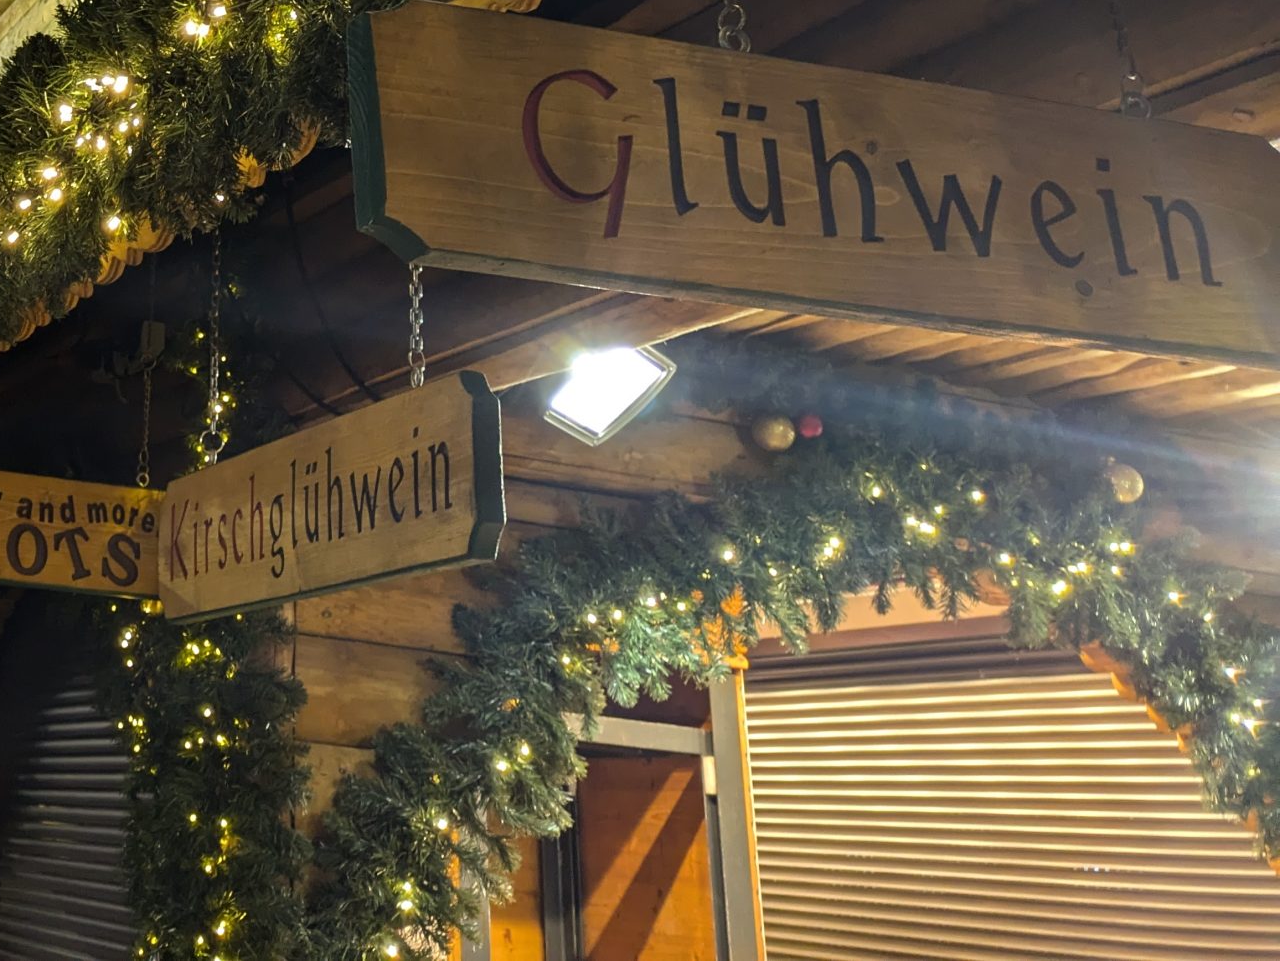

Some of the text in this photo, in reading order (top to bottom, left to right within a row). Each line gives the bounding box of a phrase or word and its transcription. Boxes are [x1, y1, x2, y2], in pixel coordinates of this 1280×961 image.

[522, 68, 1224, 288] Glühwein
[16, 494, 76, 524] and
[87, 499, 155, 533] more
[170, 427, 454, 581] Kirschglühwein
